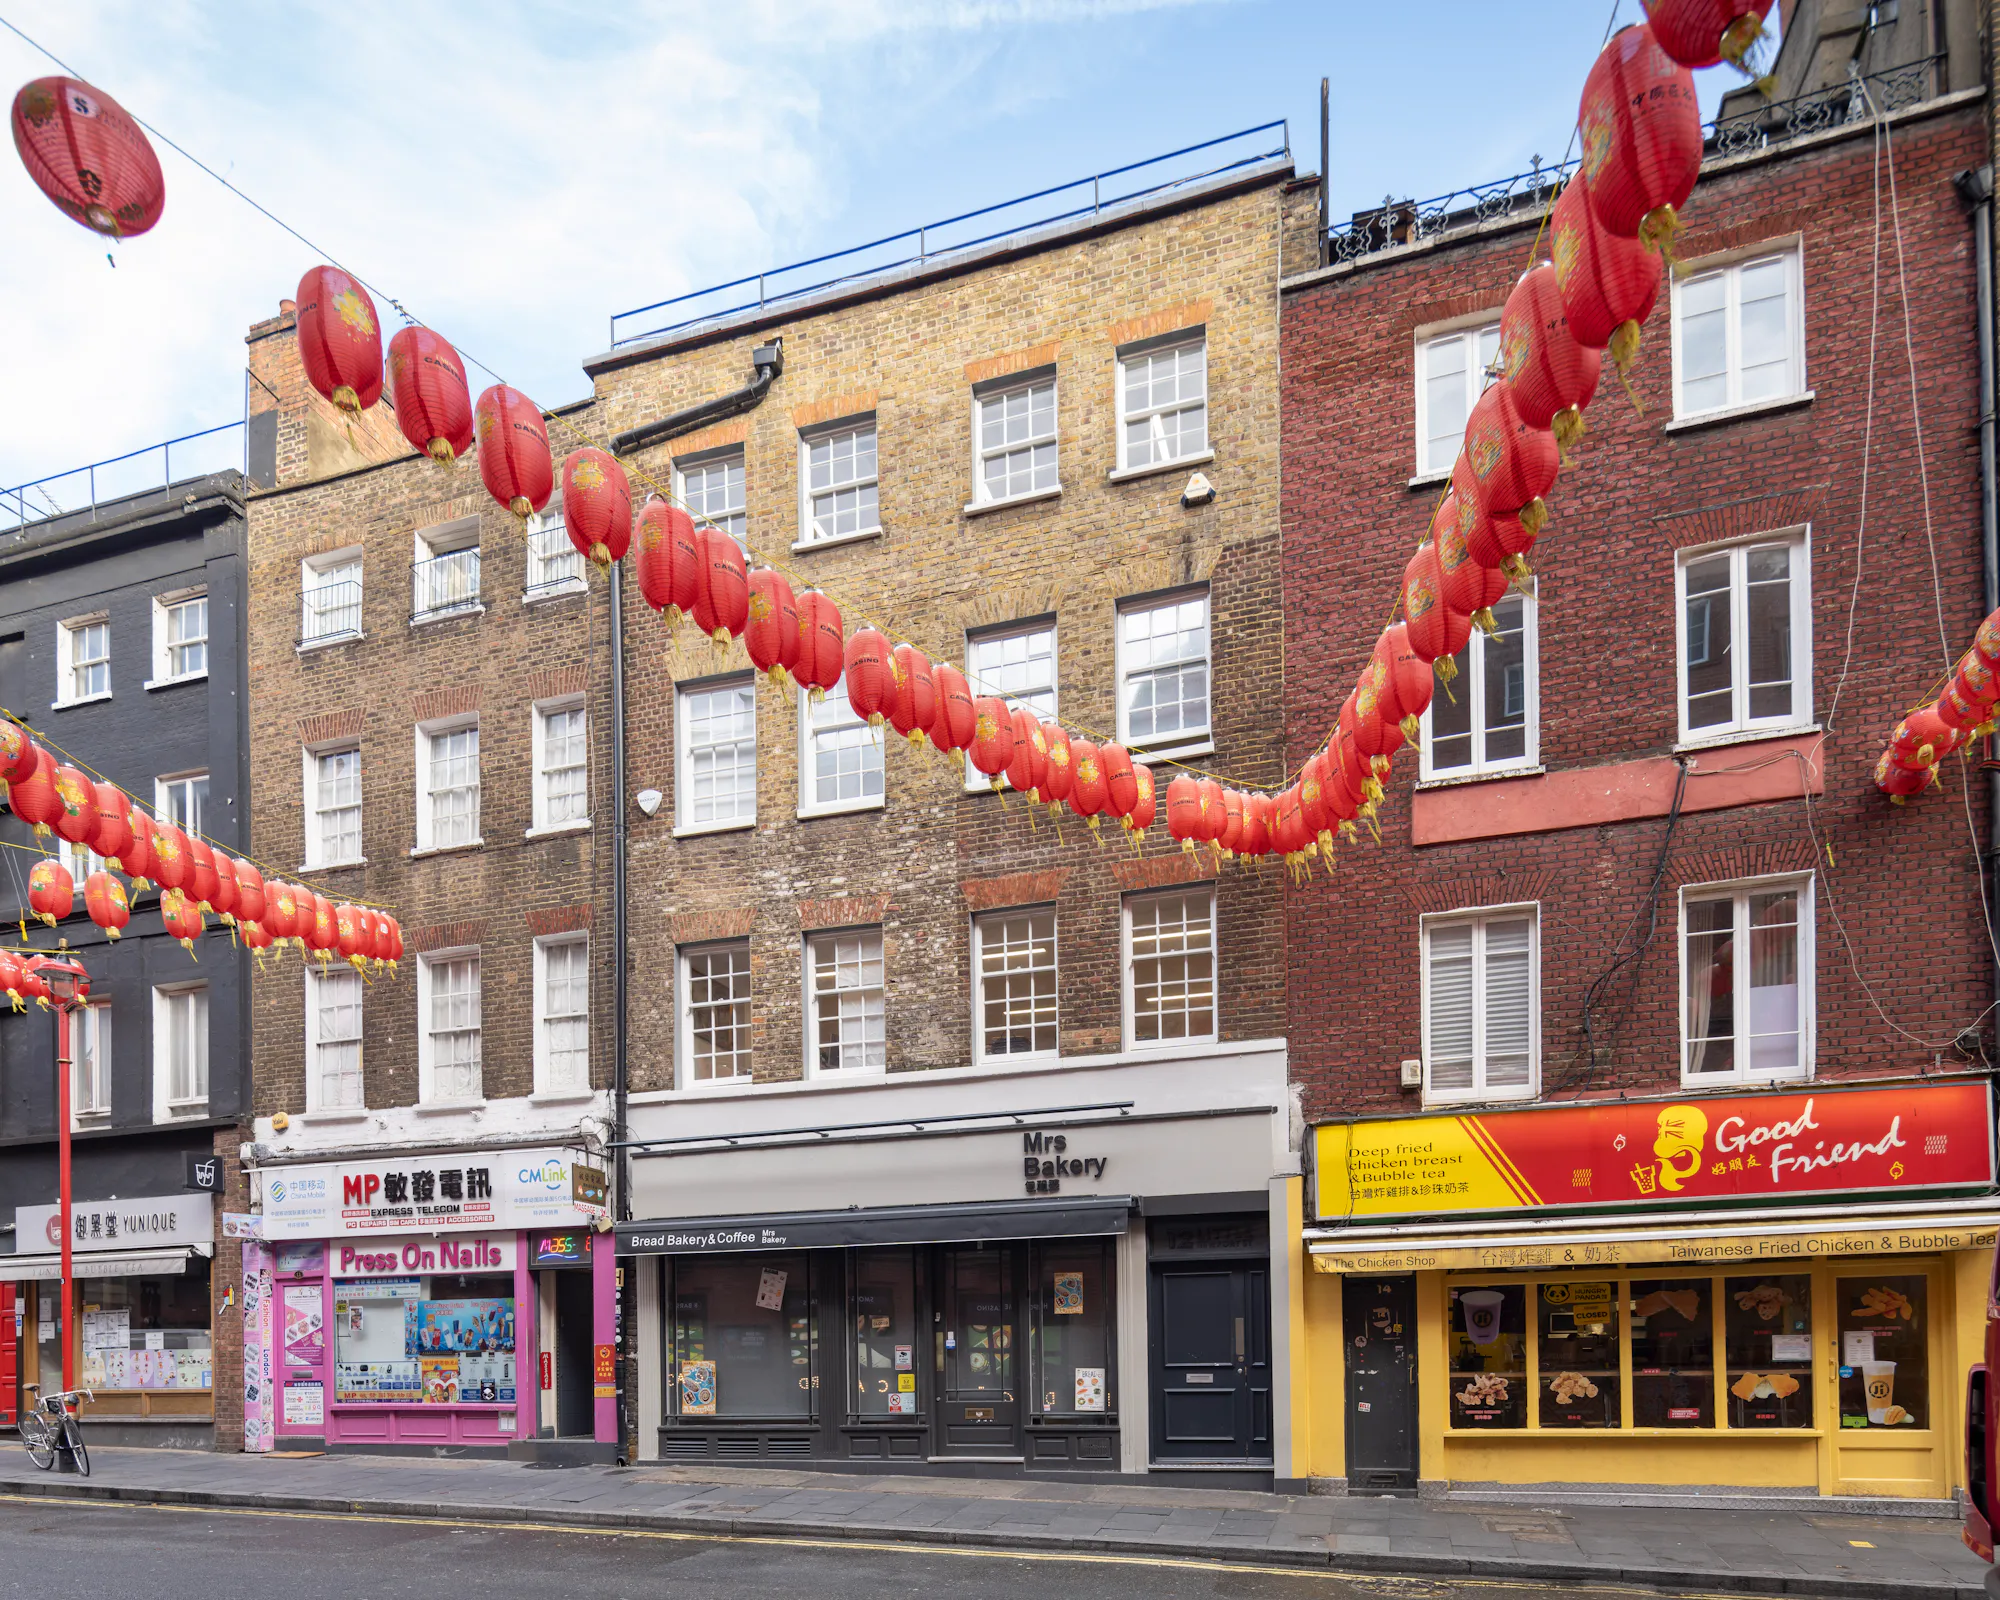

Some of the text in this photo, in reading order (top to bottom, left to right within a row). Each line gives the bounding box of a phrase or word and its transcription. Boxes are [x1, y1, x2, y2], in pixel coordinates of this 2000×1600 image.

[1715, 1097, 1820, 1153] Good
[1023, 1132, 1067, 1154] Mrs
[1349, 1142, 1434, 1159] Deep fried
[1769, 1115, 1907, 1184] Friend
[1024, 1155, 1107, 1180] Bakery
[1349, 1154, 1463, 1172] chicken breast
[1711, 1153, 1762, 1176] 好朋友
[518, 1167, 568, 1184] CMLink
[1421, 1169, 1446, 1181] tea
[289, 1179, 326, 1192] 中国移动
[343, 1174, 380, 1206] MP
[384, 1167, 492, 1204] 敏發電訊
[1349, 1182, 1470, 1201] 台灣炸雞排&珍珠奶茶
[290, 1191, 326, 1200] China Mobile
[371, 1206, 413, 1218] EXPRESS
[416, 1204, 461, 1215] TELECOM
[448, 1215, 494, 1224] ACCESSORIES
[123, 1212, 177, 1236] YUNIQUE
[631, 1234, 665, 1248] Bread
[761, 1229, 776, 1237] Mrs
[761, 1235, 787, 1246] Bakery
[1668, 1231, 1996, 1258] Taiwanese Fried Chicken & Bubble Tea
[340, 1239, 502, 1272] Press On Nails
[1563, 1248, 1575, 1262] &
[1583, 1244, 1621, 1263] 奶茶
[1321, 1255, 1436, 1270] Ji The Chicken Shop
[1376, 1284, 1392, 1294] 14
[1574, 1287, 1607, 1295] HUNGRY
[262, 1299, 271, 1327] Fashion
[1575, 1311, 1608, 1320] CLOSED
[262, 1328, 271, 1347] Nails
[262, 1349, 271, 1377] London
[1873, 1383, 1884, 1395] Ji
